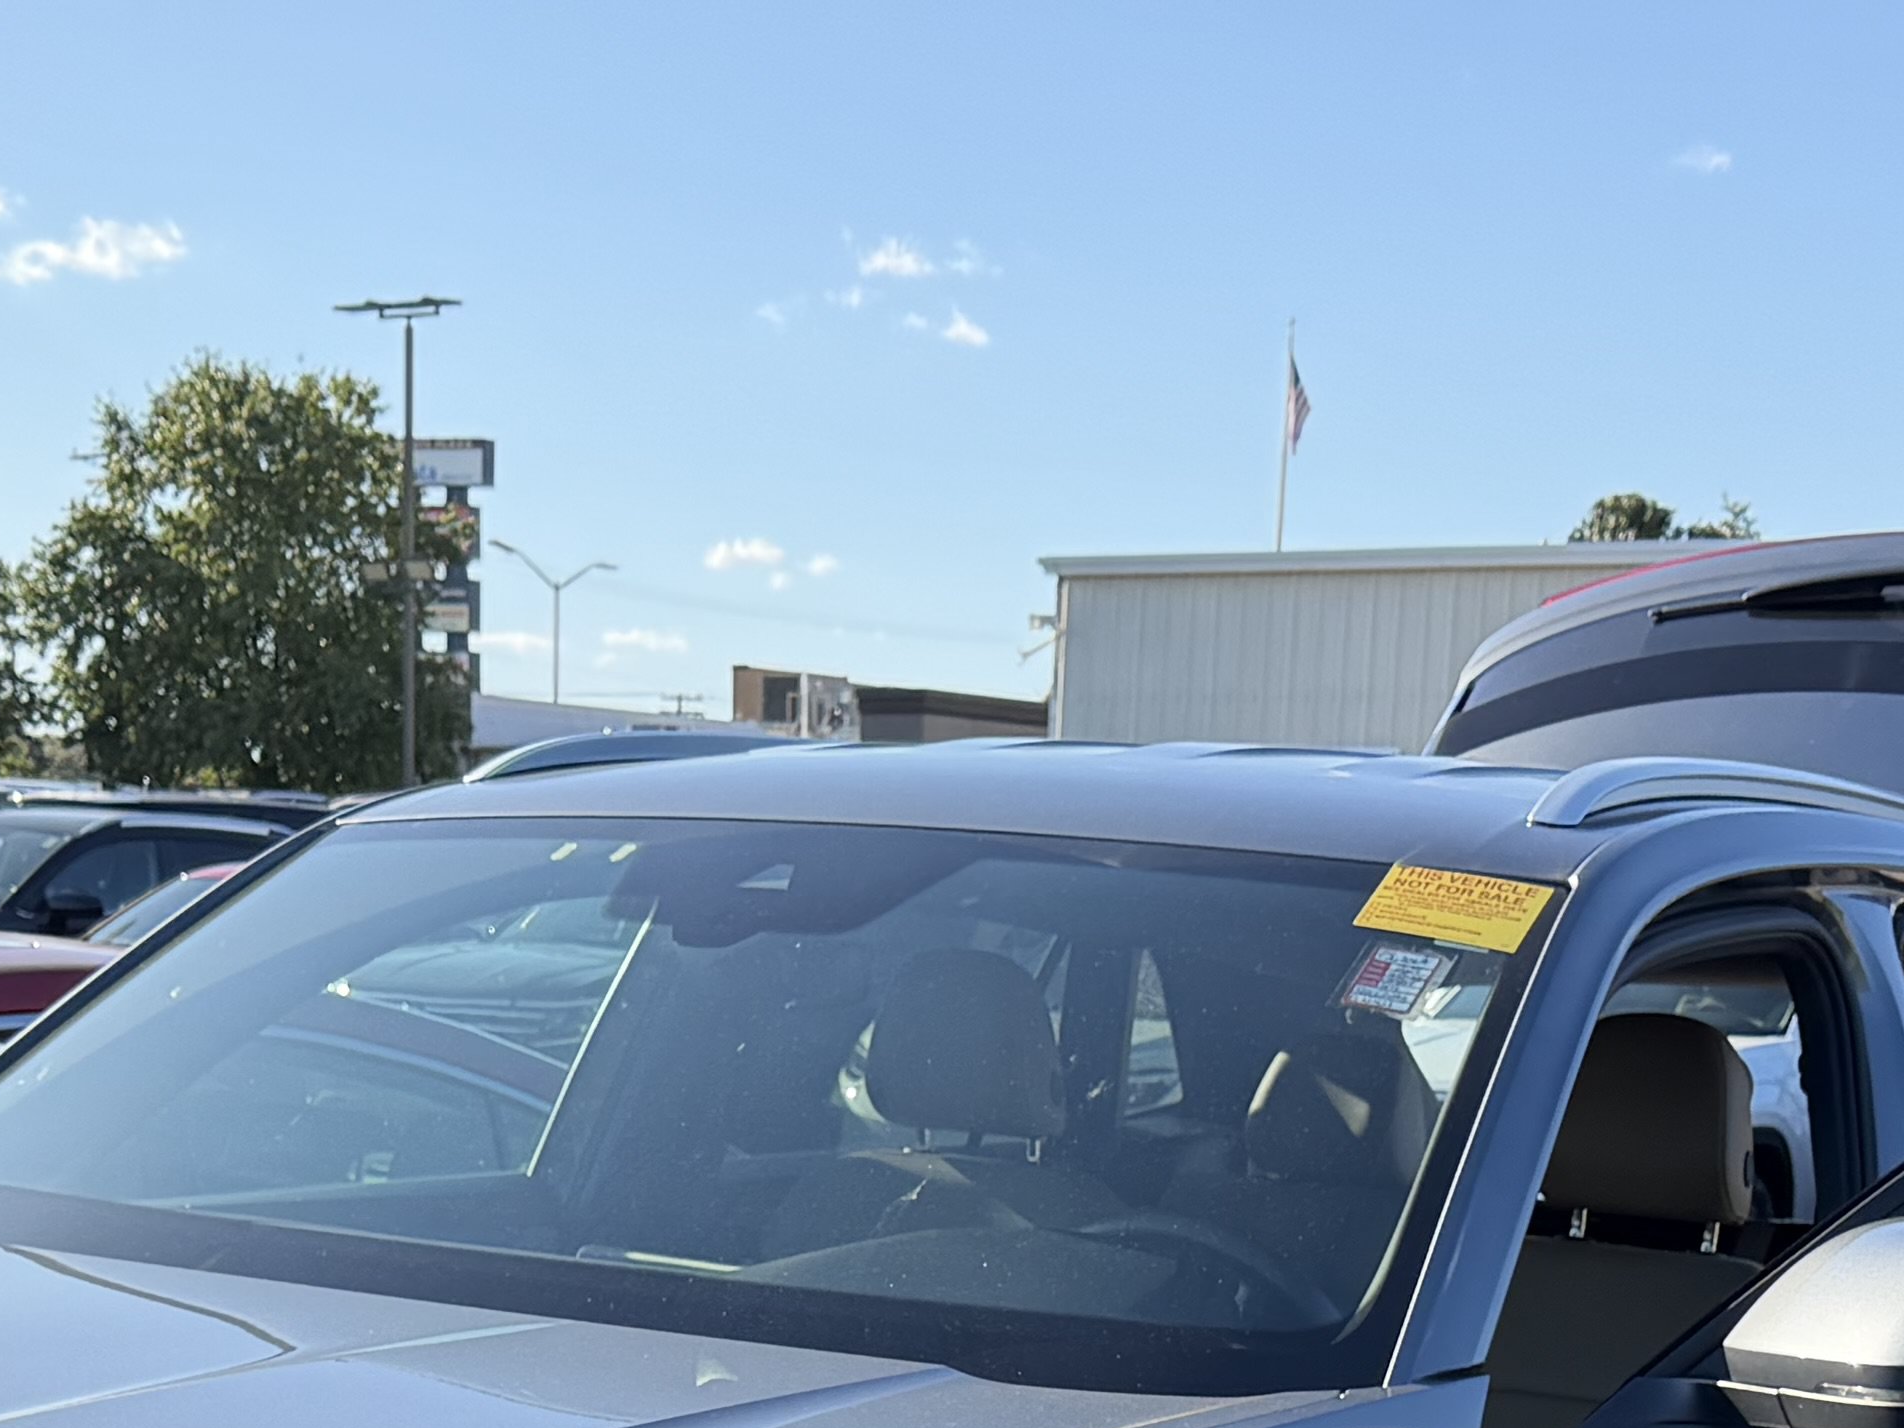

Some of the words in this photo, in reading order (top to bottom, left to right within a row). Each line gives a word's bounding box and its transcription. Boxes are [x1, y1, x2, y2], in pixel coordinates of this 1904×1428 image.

[1392, 878, 1431, 890] NOT
[1434, 883, 1475, 898] FOR
[1478, 890, 1527, 906] SALE
[1396, 866, 1443, 881] THIS
[1449, 871, 1540, 899] VEHICLE
